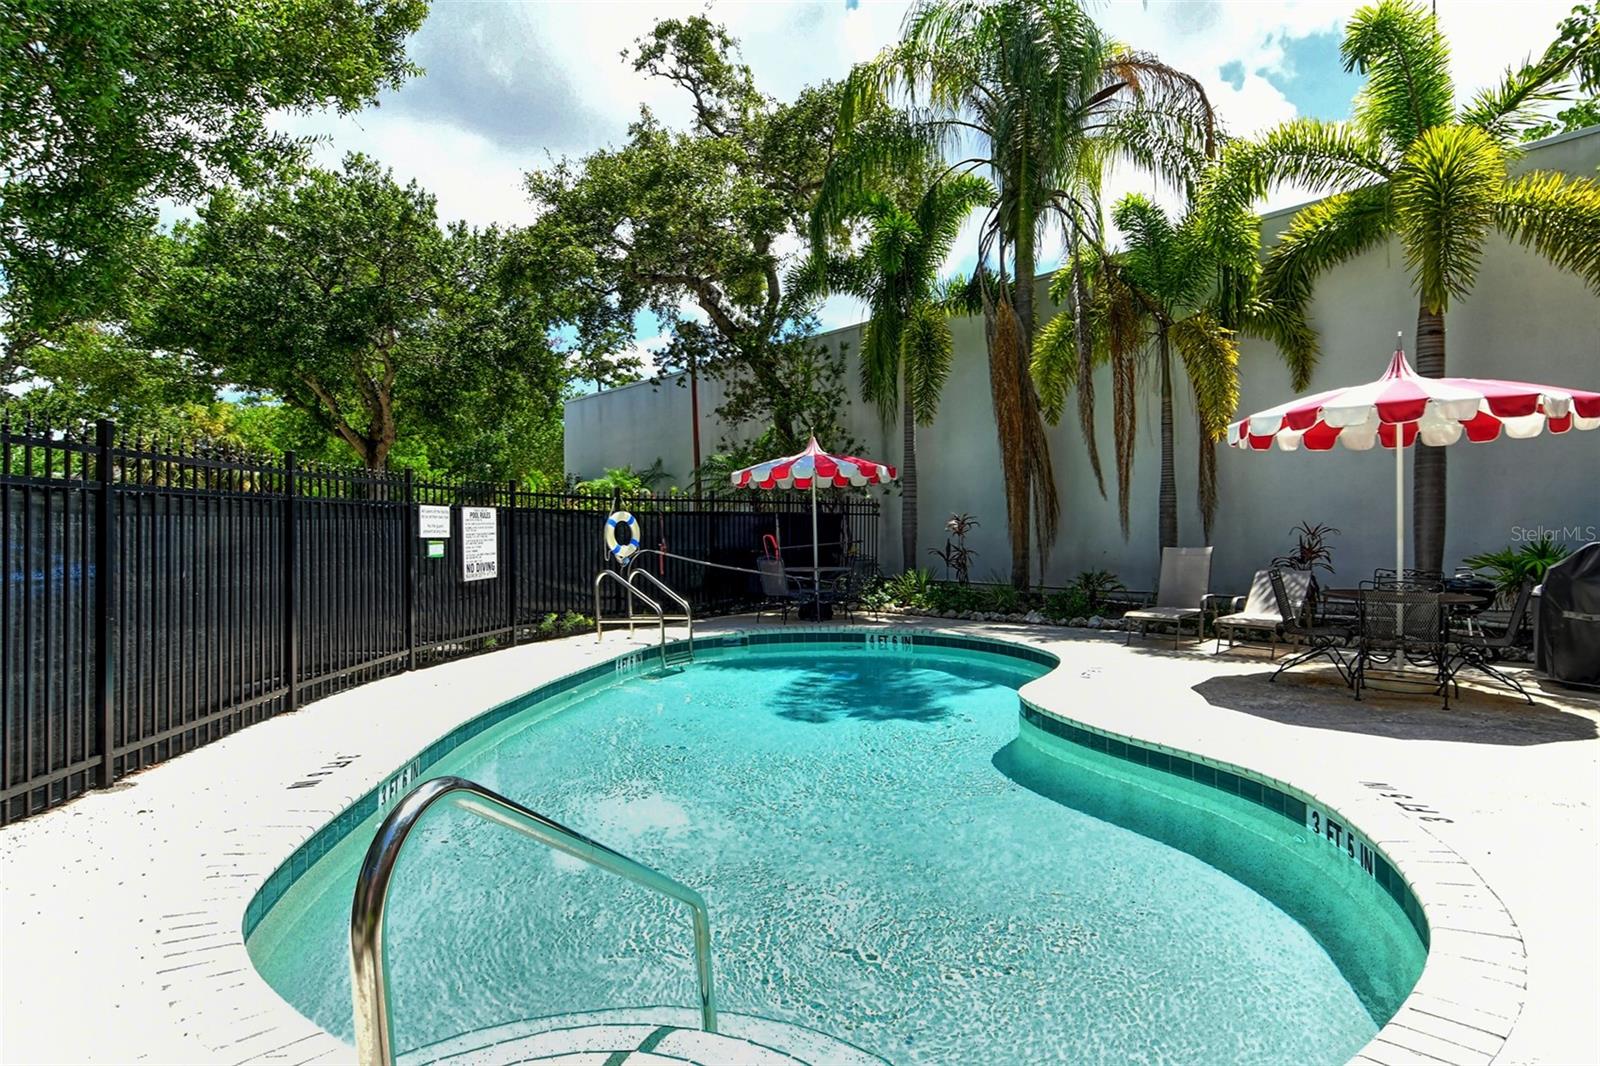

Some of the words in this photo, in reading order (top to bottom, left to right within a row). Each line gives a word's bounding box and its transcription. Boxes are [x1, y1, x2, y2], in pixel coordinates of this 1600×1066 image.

[466, 563, 475, 573] NO
[476, 561, 495, 573] DIVING
[878, 634, 889, 644] FT
[901, 635, 912, 645] IN
[381, 784, 387, 806] 3
[389, 774, 399, 799] FT
[402, 769, 408, 789] 6
[410, 760, 419, 782] IN
[1311, 811, 1320, 834] 3
[1326, 817, 1342, 848] FT
[1347, 832, 1355, 859] 5
[1360, 842, 1373, 876] IN
